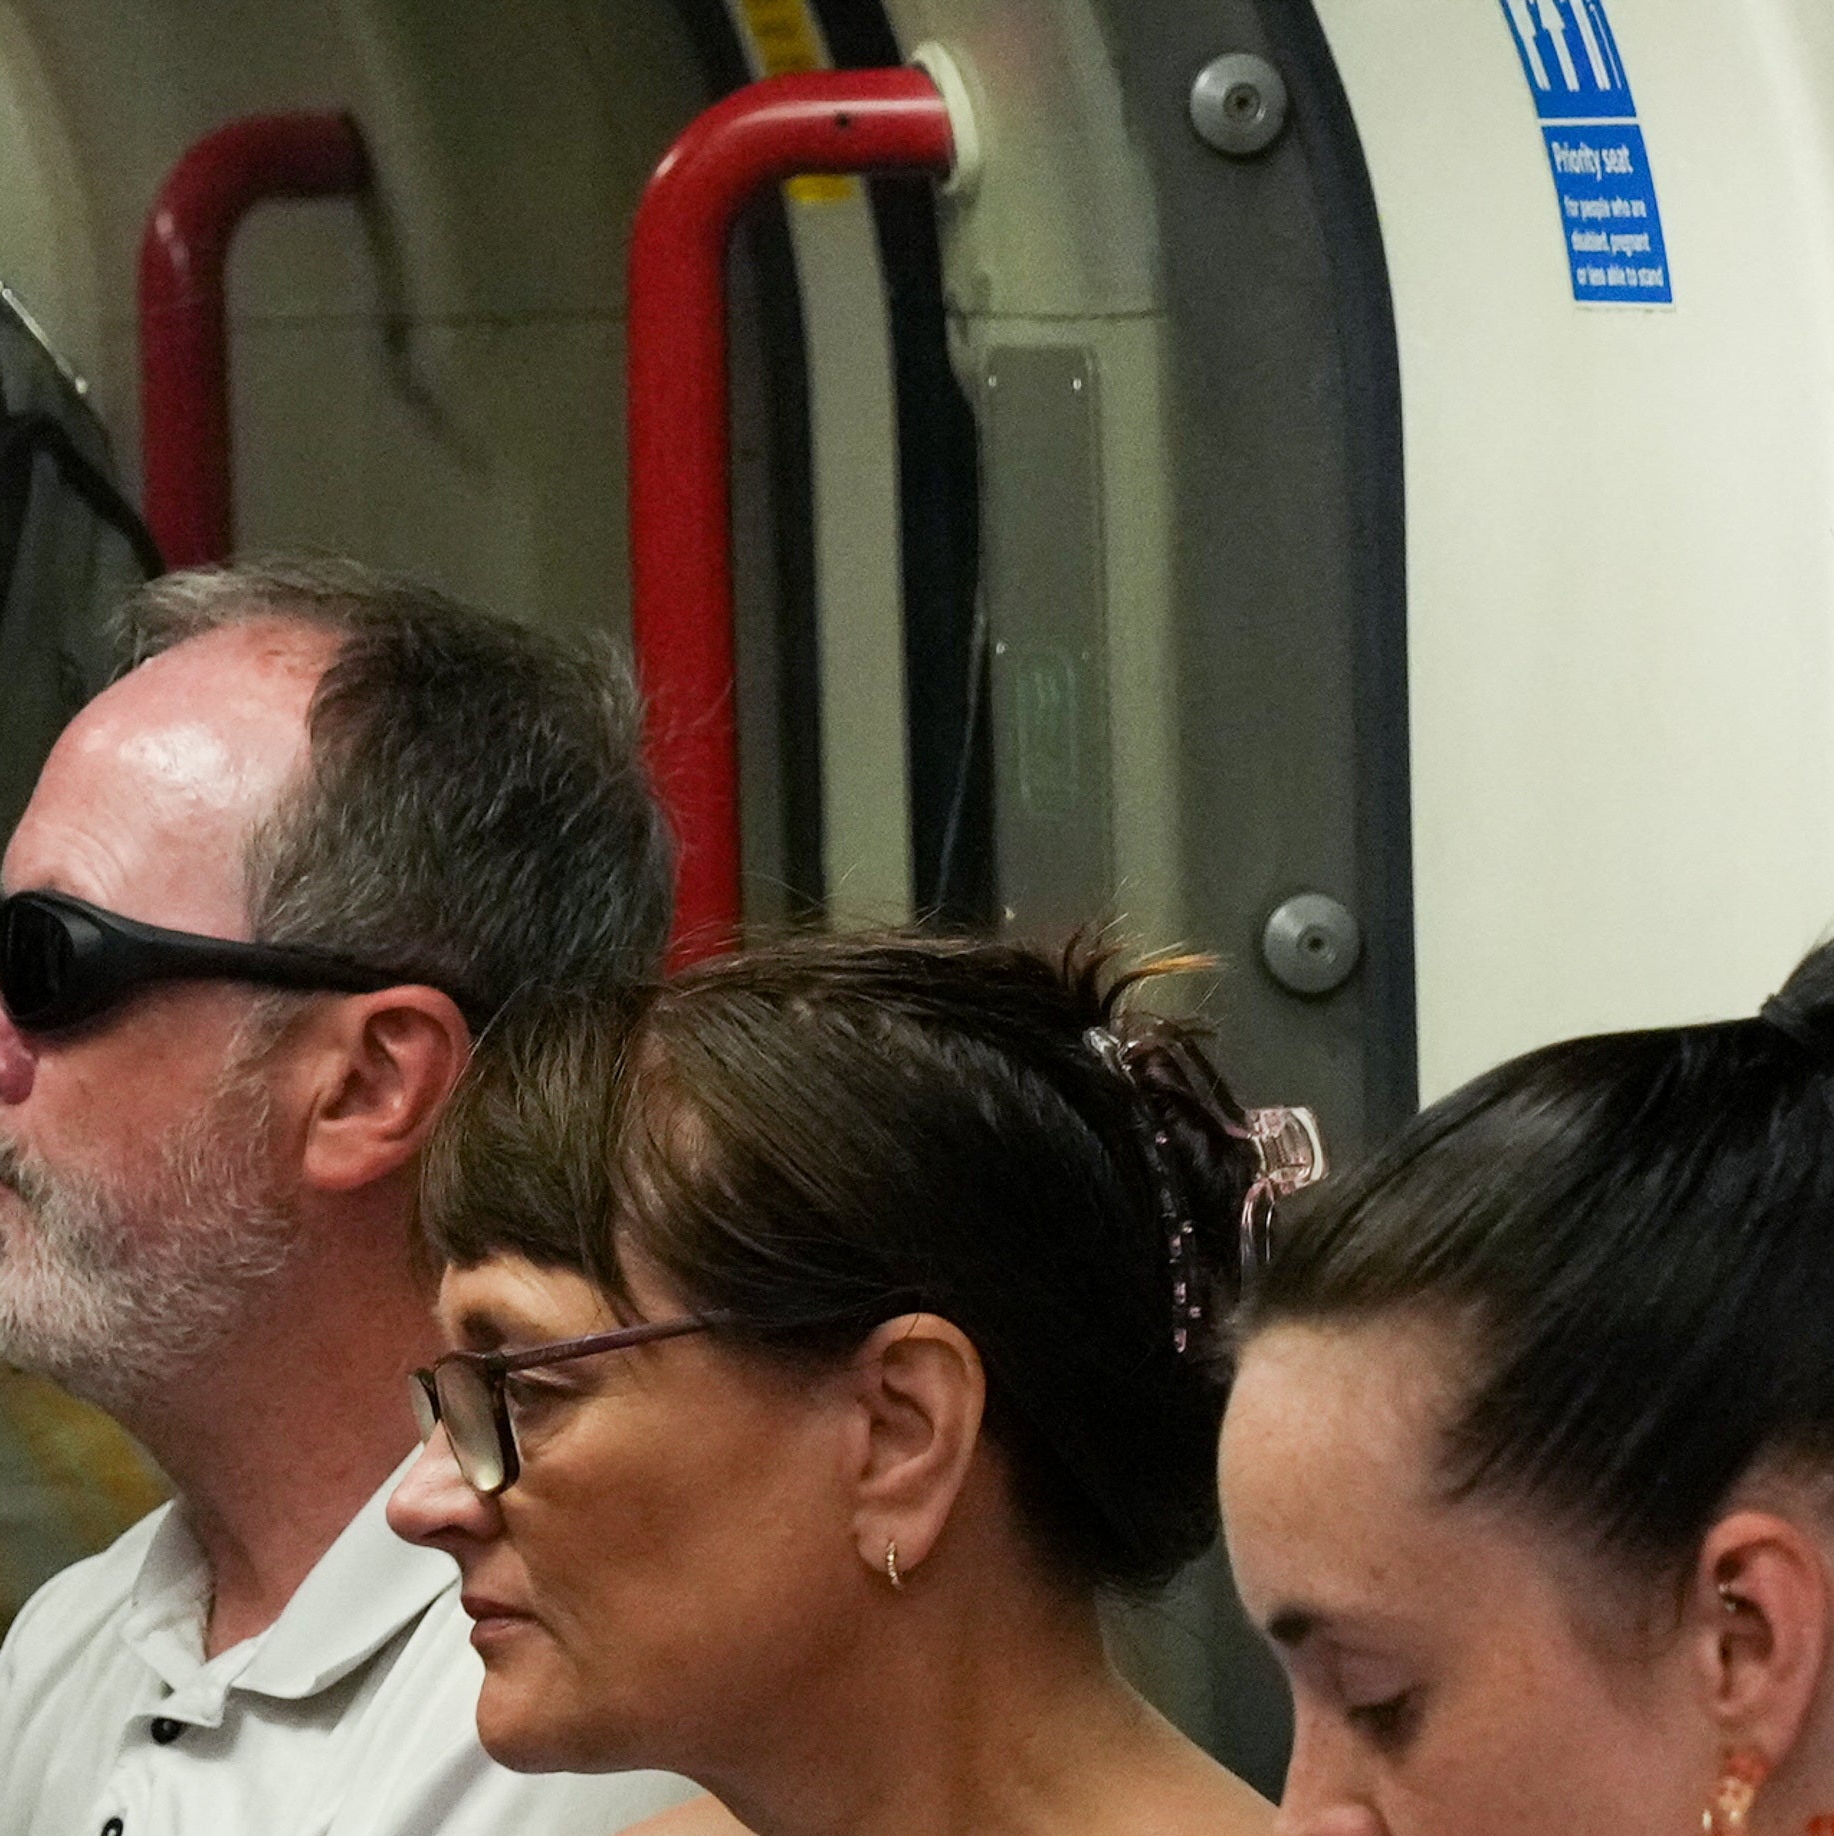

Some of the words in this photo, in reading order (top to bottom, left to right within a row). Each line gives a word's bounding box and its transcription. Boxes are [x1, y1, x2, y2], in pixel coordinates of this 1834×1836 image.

[1551, 142, 1602, 181] Priority
[1602, 144, 1633, 174] seat
[1579, 197, 1610, 221] people
[1610, 195, 1631, 217] who
[1631, 200, 1647, 217] are
[1610, 232, 1650, 257] pregnant
[1576, 268, 1587, 285] or
[1586, 264, 1606, 285] less
[1606, 264, 1625, 286] able
[1626, 266, 1637, 286] to
[1637, 265, 1664, 287] stand
